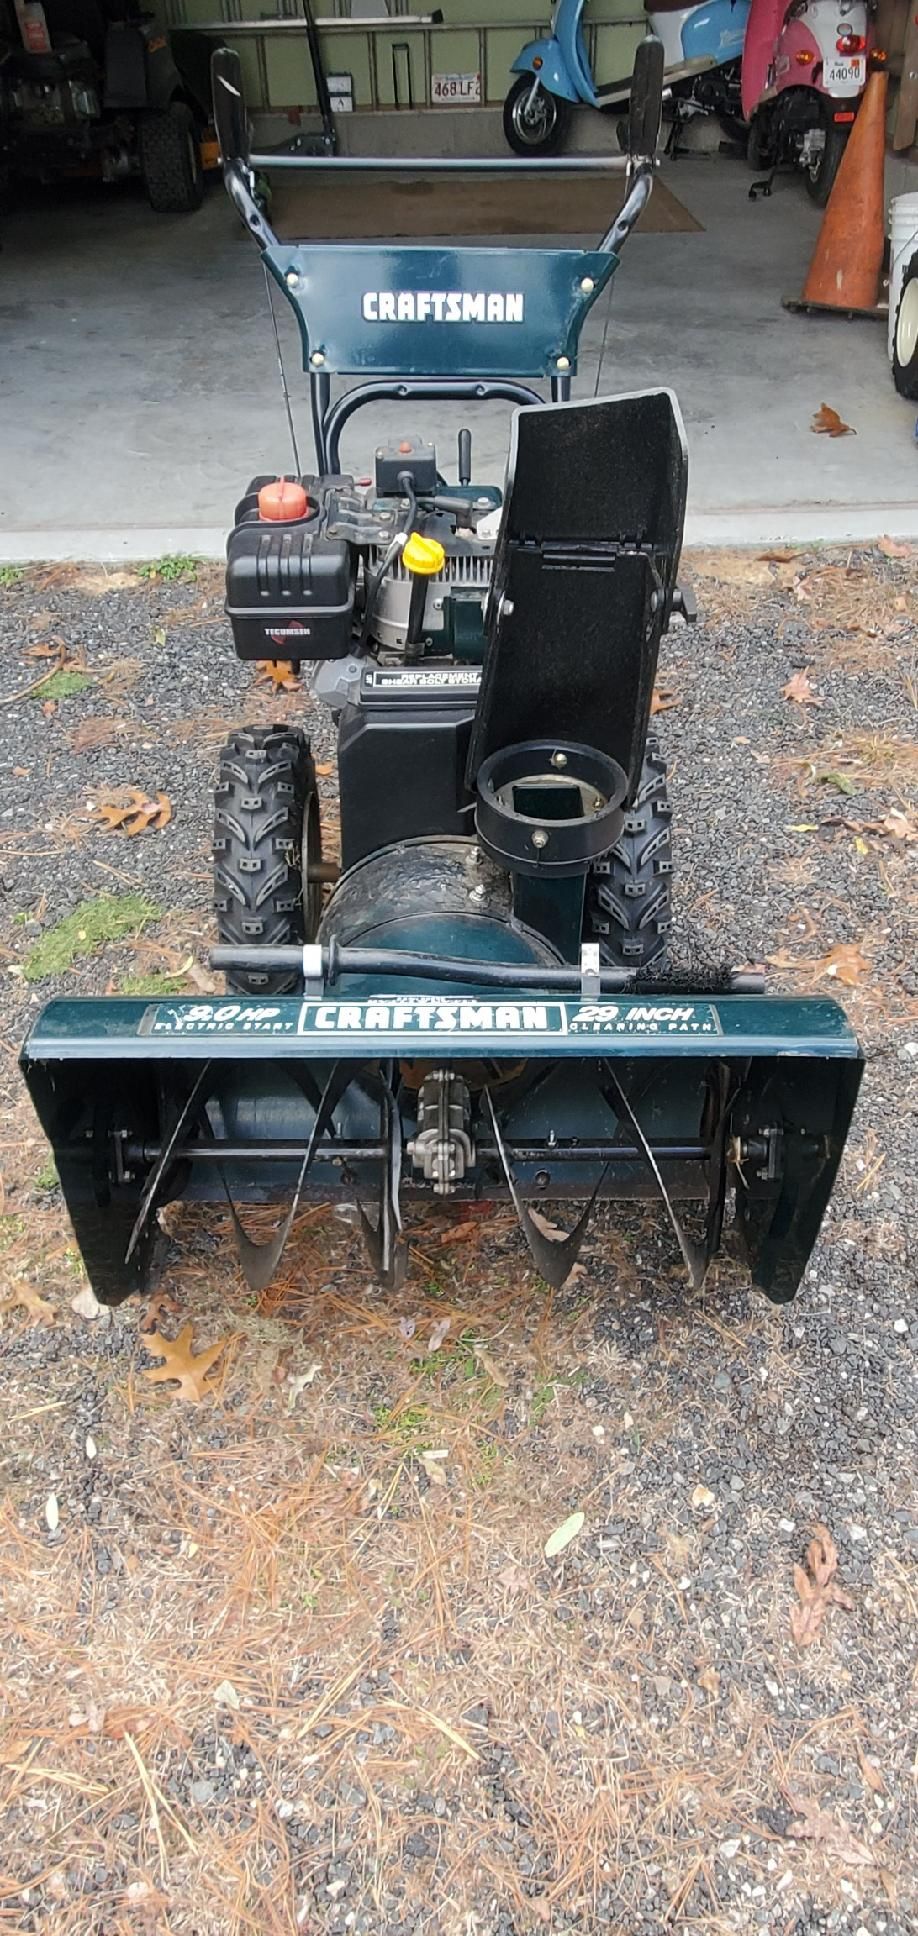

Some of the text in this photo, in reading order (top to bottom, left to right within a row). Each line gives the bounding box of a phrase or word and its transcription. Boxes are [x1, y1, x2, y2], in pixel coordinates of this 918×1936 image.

[435, 81, 457, 96] 468
[363, 292, 524, 321] CRAFTSMAN
[314, 1006, 548, 1029] CRAFTSMAN
[572, 1005, 694, 1022] 29 INCH
[154, 1022, 293, 1031] ELECTRIC START
[569, 1022, 711, 1031] CLEARING PATH
